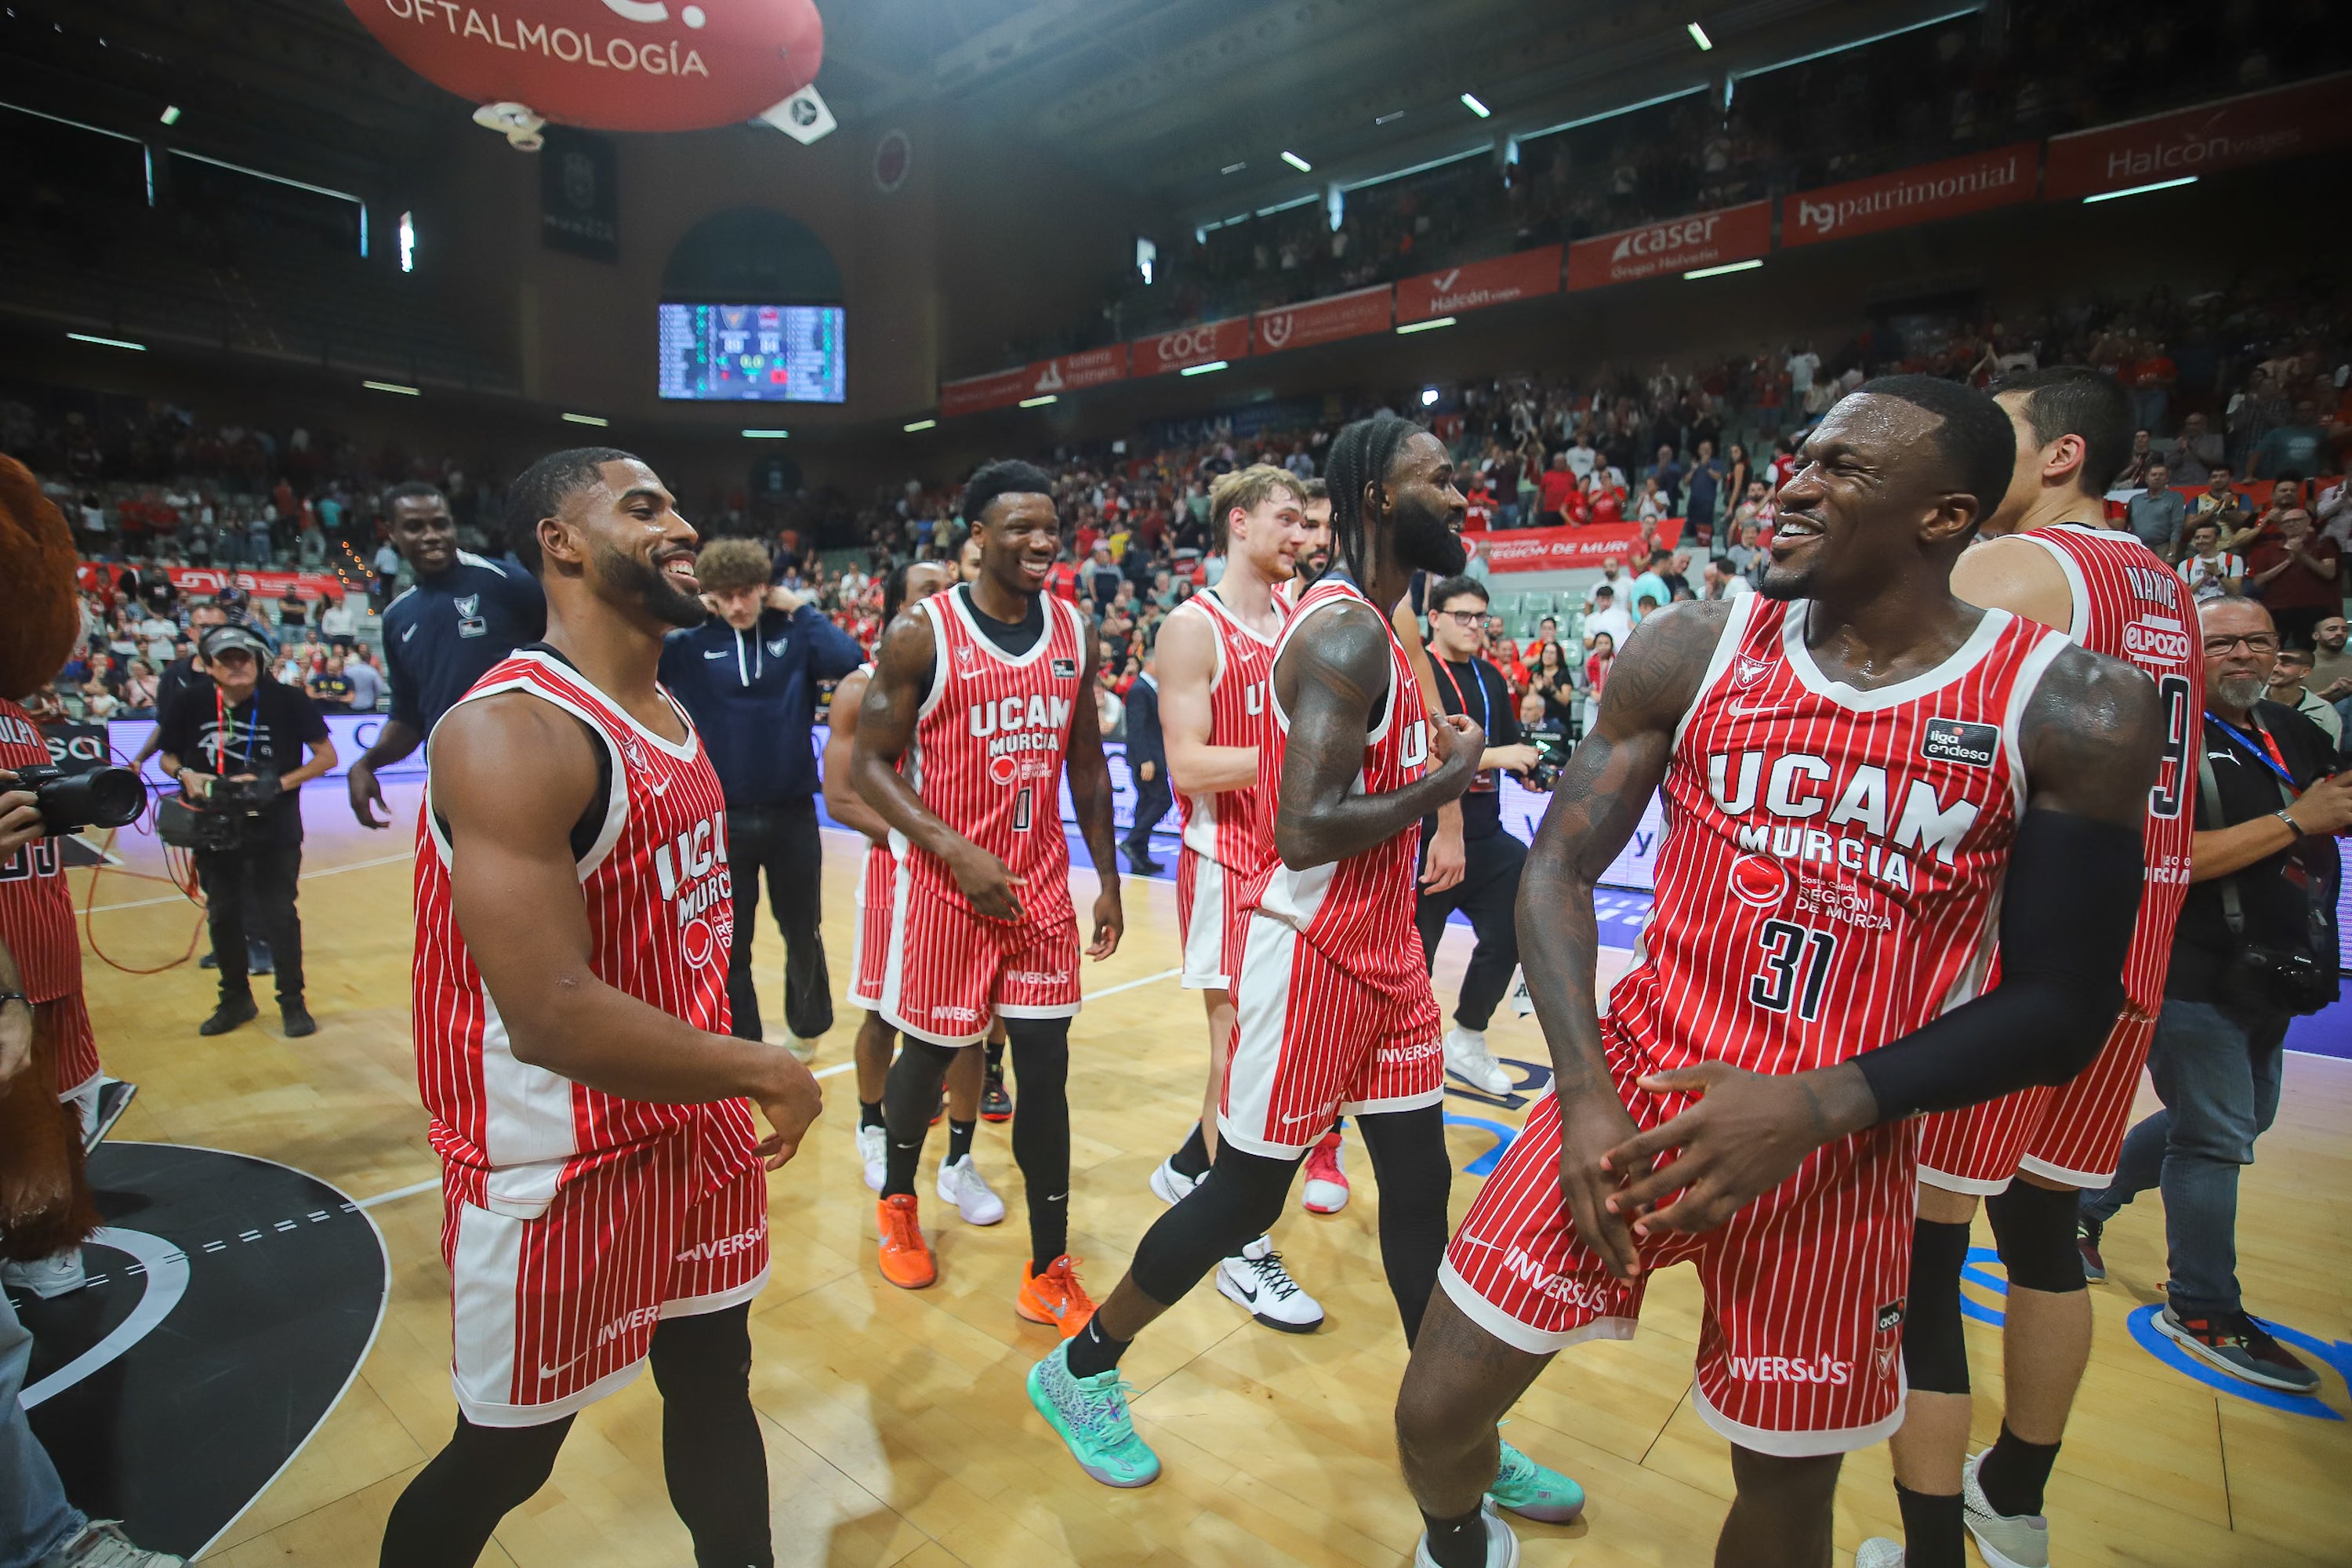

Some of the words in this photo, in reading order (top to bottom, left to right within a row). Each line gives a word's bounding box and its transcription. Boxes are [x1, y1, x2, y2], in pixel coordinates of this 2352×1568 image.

[387, 0, 709, 78] OFTALMOLOGÍA
[1837, 158, 2017, 226] patrimonial
[1632, 216, 1720, 255] caser
[1552, 542, 1577, 556] DE
[970, 695, 1072, 739] UCAM
[1929, 729, 1959, 746] liga
[989, 731, 1060, 758] MURCIA
[1928, 743, 1990, 763] endesa
[2144, 671, 2191, 820] 9
[1708, 750, 1982, 867] UCAM
[655, 811, 728, 902] UCA
[1738, 823, 1910, 892] MURCIA
[679, 869, 732, 928] MURC
[1795, 896, 1820, 914] DE
[1825, 904, 1893, 931] MURCIA
[1798, 886, 1869, 913] REGIÓN
[1748, 917, 1838, 1023] 31
[931, 1005, 978, 1022] INVERS
[1376, 1036, 1443, 1063] INVERSUS
[1502, 1245, 1607, 1313] INVERSUS
[597, 1305, 659, 1348] INVER
[1879, 1311, 1900, 1329] acb
[1728, 1351, 1849, 1385] NVERSUS
